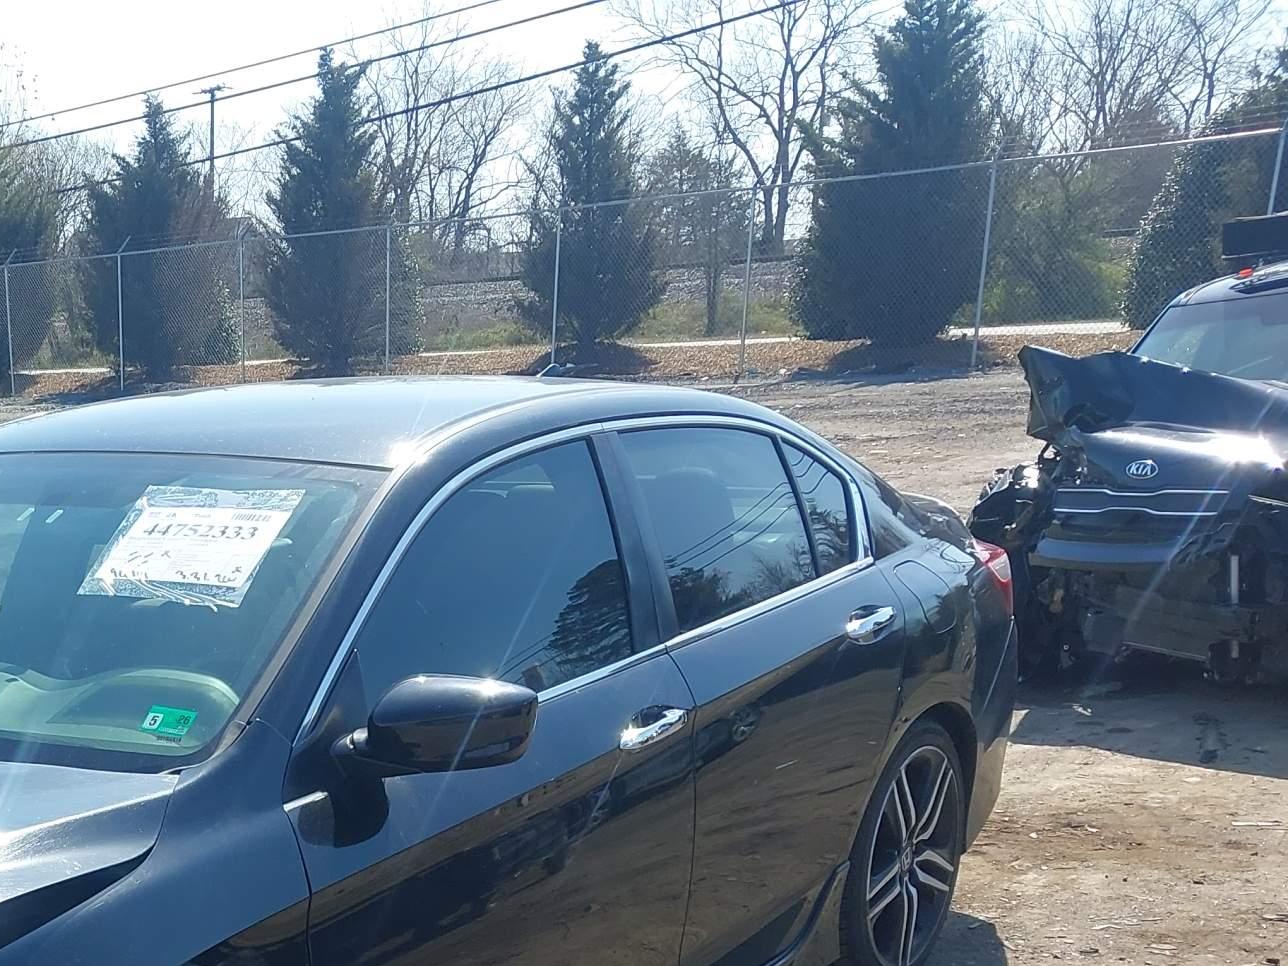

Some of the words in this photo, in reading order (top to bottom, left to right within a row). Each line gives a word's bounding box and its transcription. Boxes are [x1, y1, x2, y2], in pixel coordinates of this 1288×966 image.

[1129, 463, 1152, 475] KIA
[143, 523, 259, 540] 44752333
[148, 715, 160, 727] 5
[177, 714, 192, 726] 26
